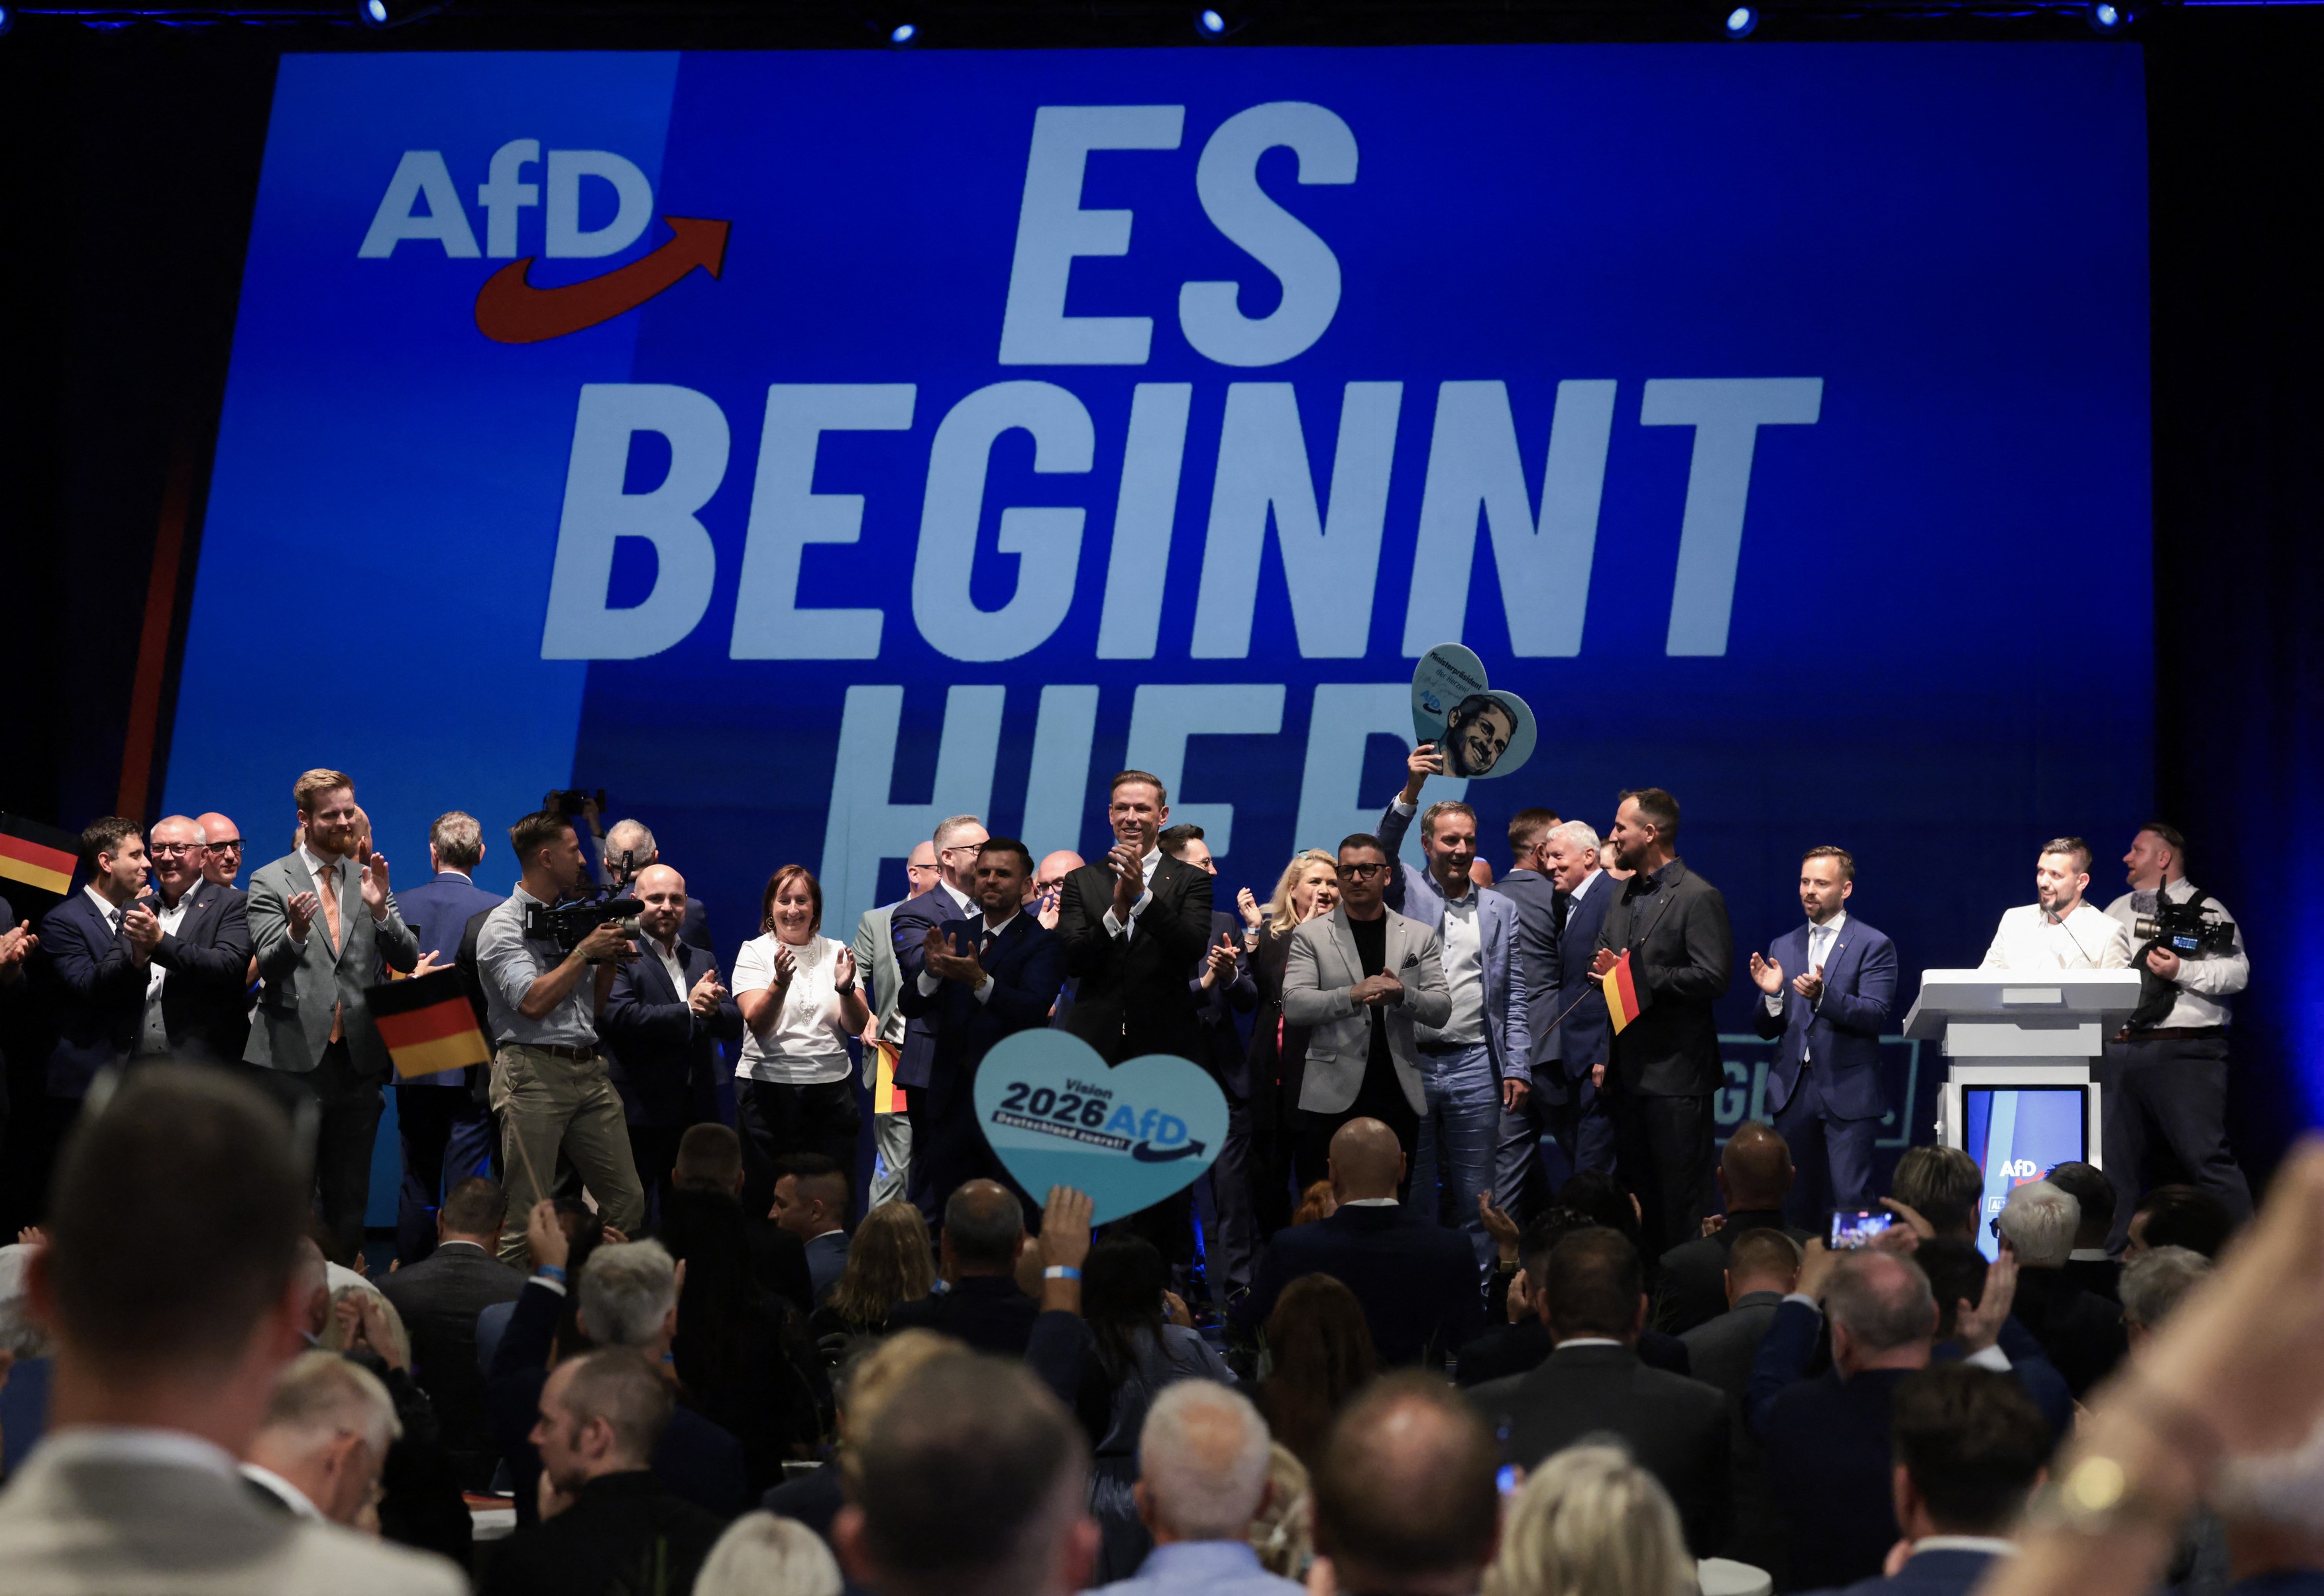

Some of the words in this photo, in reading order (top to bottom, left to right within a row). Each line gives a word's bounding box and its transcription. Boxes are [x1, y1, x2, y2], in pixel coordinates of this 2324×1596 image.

[359, 140, 652, 257] AfD
[999, 102, 1358, 367] ES
[541, 378, 1822, 661] BEGINNT
[1430, 651, 1482, 691] Ministerpräsident
[1436, 669, 1446, 678] der
[1447, 675, 1470, 694] Herzen!
[1420, 689, 1441, 709] AfD
[1000, 1082, 1107, 1127] 2026
[1066, 1078, 1113, 1099] Vision
[1103, 1104, 1188, 1145] AfD
[1999, 1159, 2036, 1176] AfD
